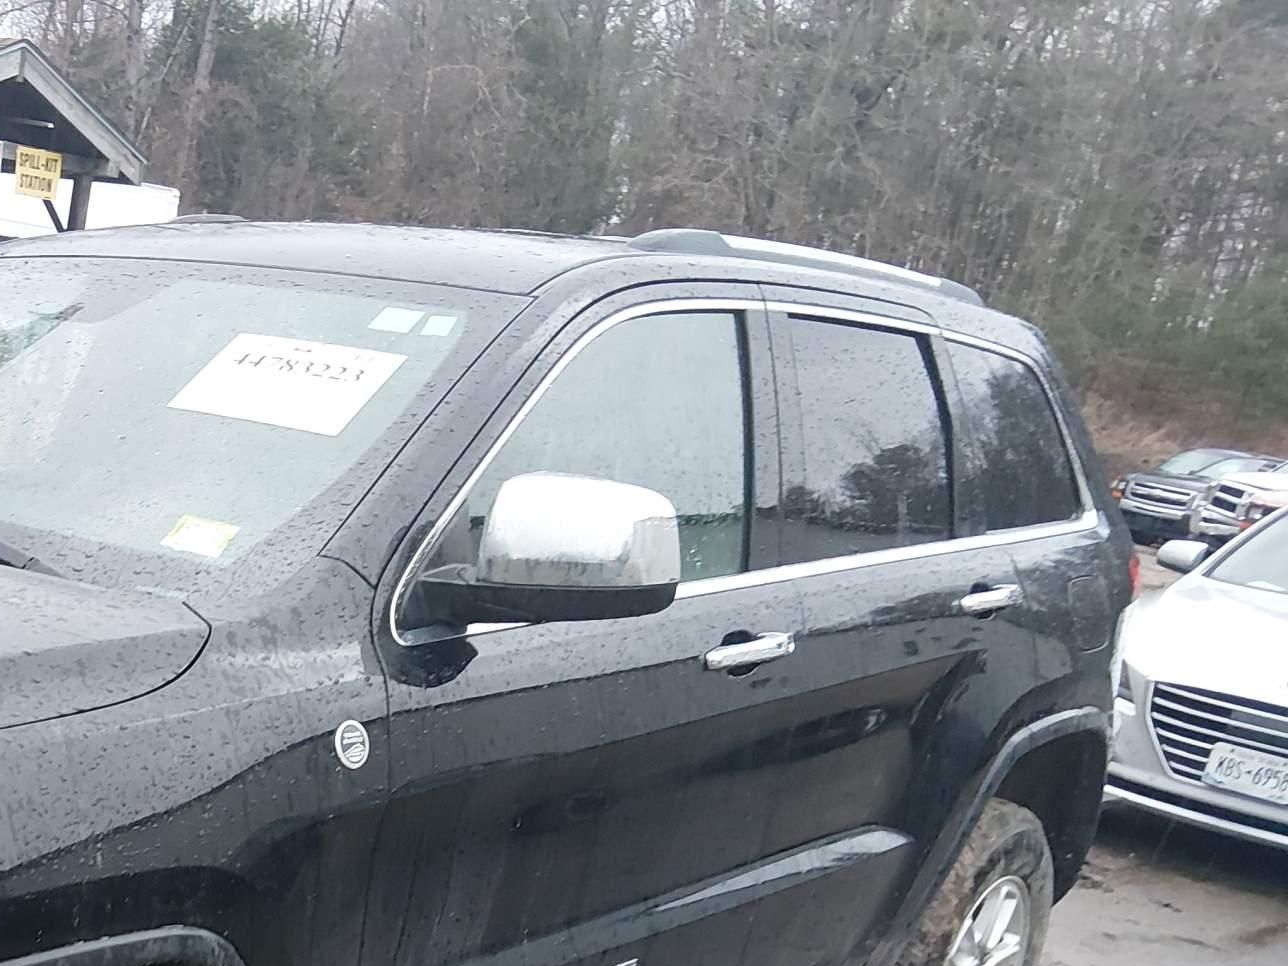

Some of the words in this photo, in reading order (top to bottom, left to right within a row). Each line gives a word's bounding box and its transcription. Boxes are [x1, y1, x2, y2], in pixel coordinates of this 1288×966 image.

[19, 152, 59, 173] SPILL-KIT
[20, 174, 53, 192] STATION
[233, 352, 365, 382] 44783223
